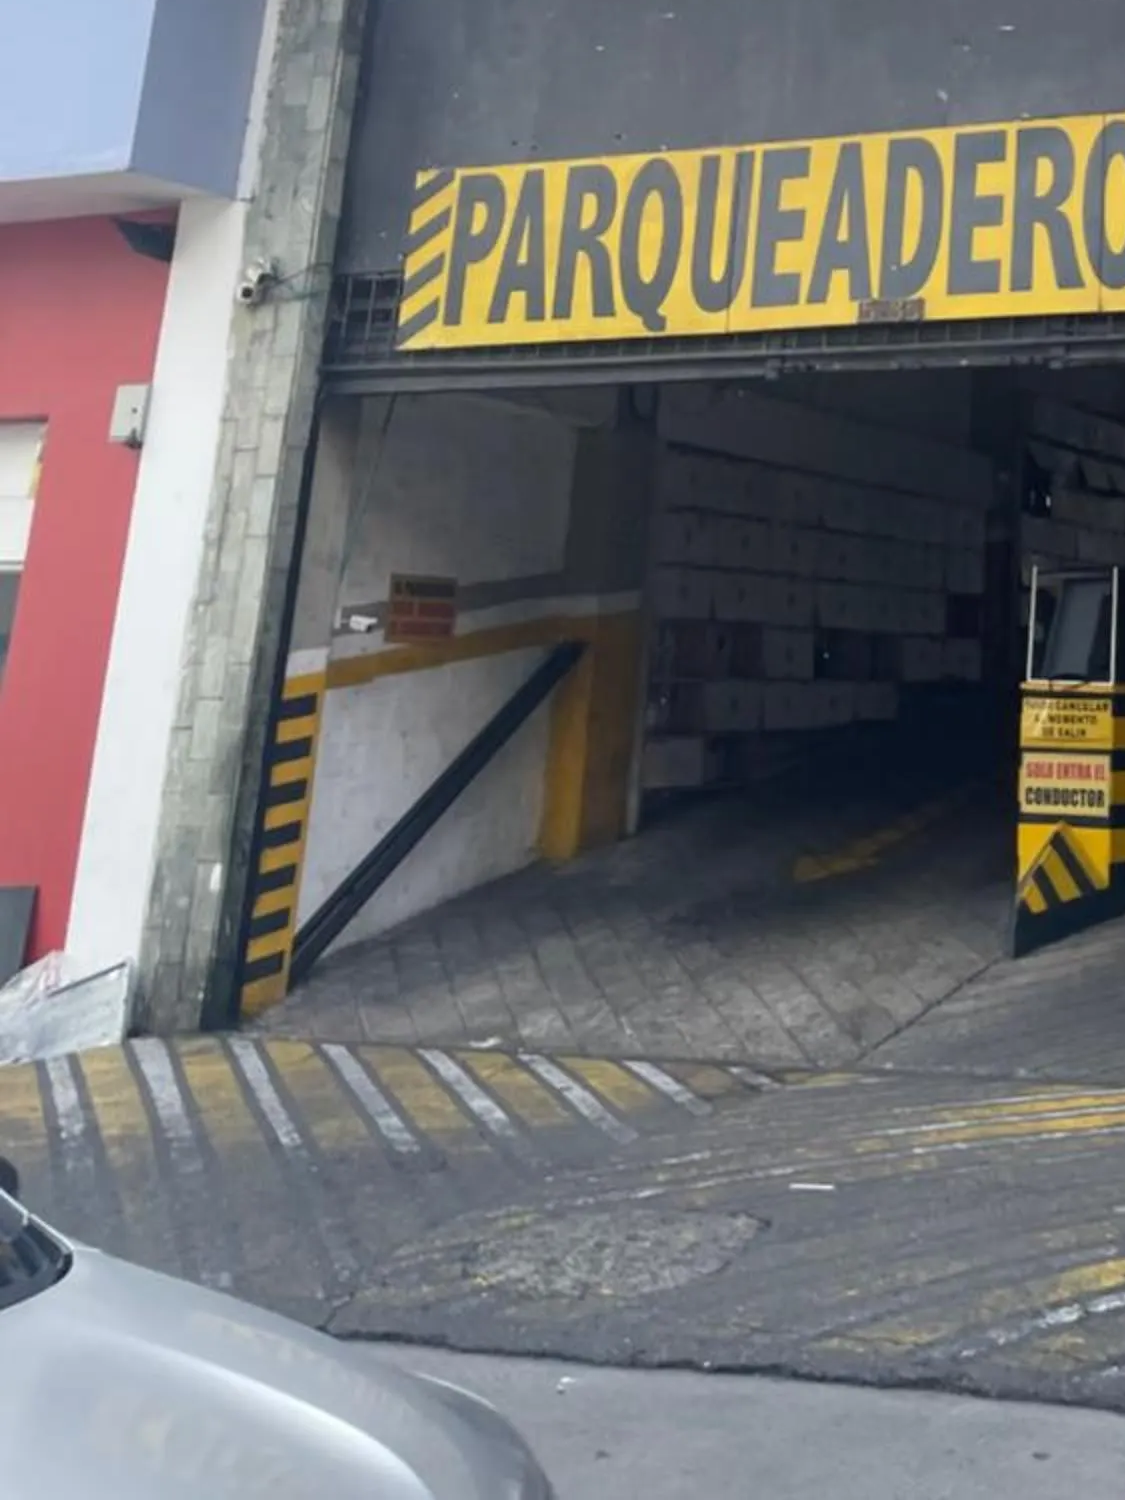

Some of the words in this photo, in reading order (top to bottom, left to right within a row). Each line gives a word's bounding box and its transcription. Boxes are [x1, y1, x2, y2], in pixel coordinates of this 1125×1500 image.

[1026, 761, 1054, 779] SOLO
[1056, 762, 1093, 780] ENTRA
[1094, 763, 1105, 780] EL
[1025, 786, 1105, 809] CONDUCTOR
